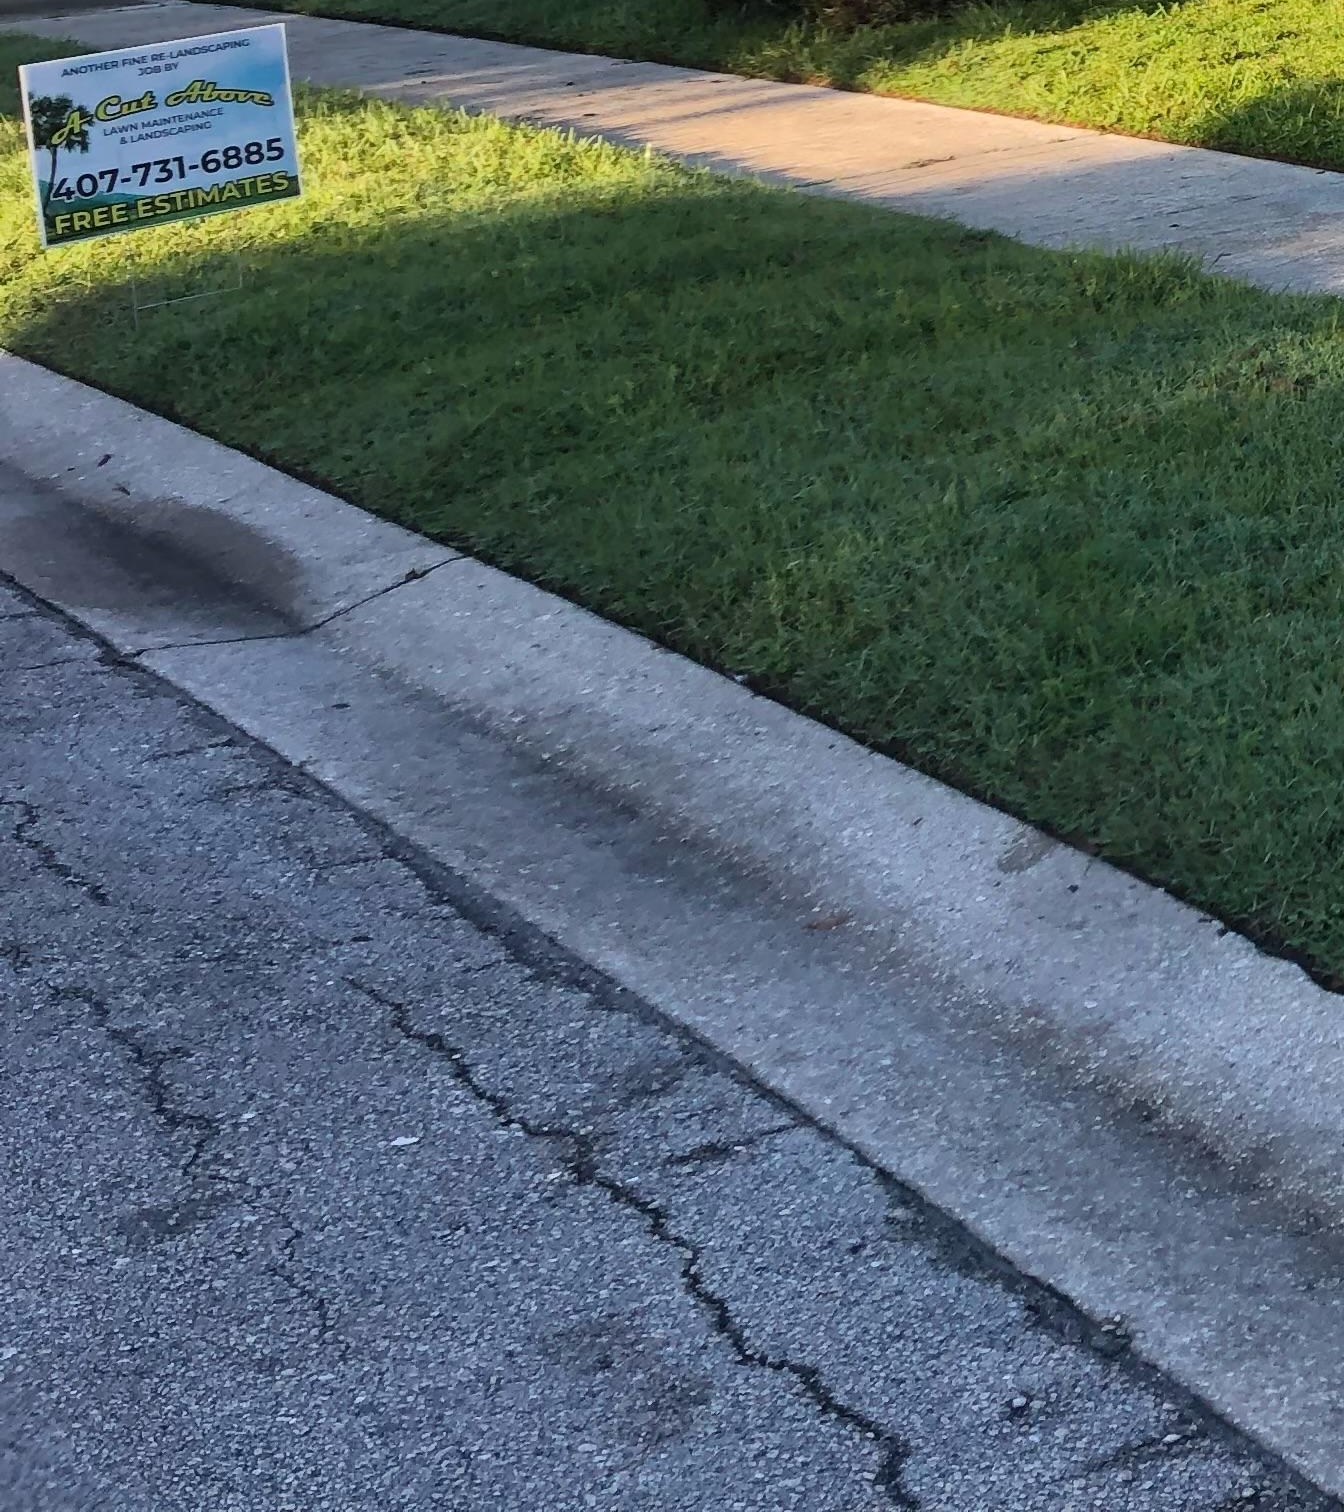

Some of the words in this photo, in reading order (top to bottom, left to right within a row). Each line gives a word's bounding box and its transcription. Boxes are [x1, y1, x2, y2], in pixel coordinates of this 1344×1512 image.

[61, 60, 119, 77] ANOTHER
[122, 55, 149, 67] FINE
[151, 38, 250, 62] RE-LANDSCAPING
[138, 65, 161, 76] JOB
[164, 62, 179, 72] BY
[51, 108, 92, 146] A
[95, 90, 158, 121] Cut
[165, 79, 275, 107] Above
[103, 121, 139, 137] LAWN
[141, 107, 225, 130] MAINTENANCE
[119, 135, 128, 145] &
[130, 120, 213, 144] LANDSCAPING
[52, 137, 285, 202] 407-731-6885
[55, 202, 128, 235] FREE
[137, 170, 290, 219] ESTIMATES
